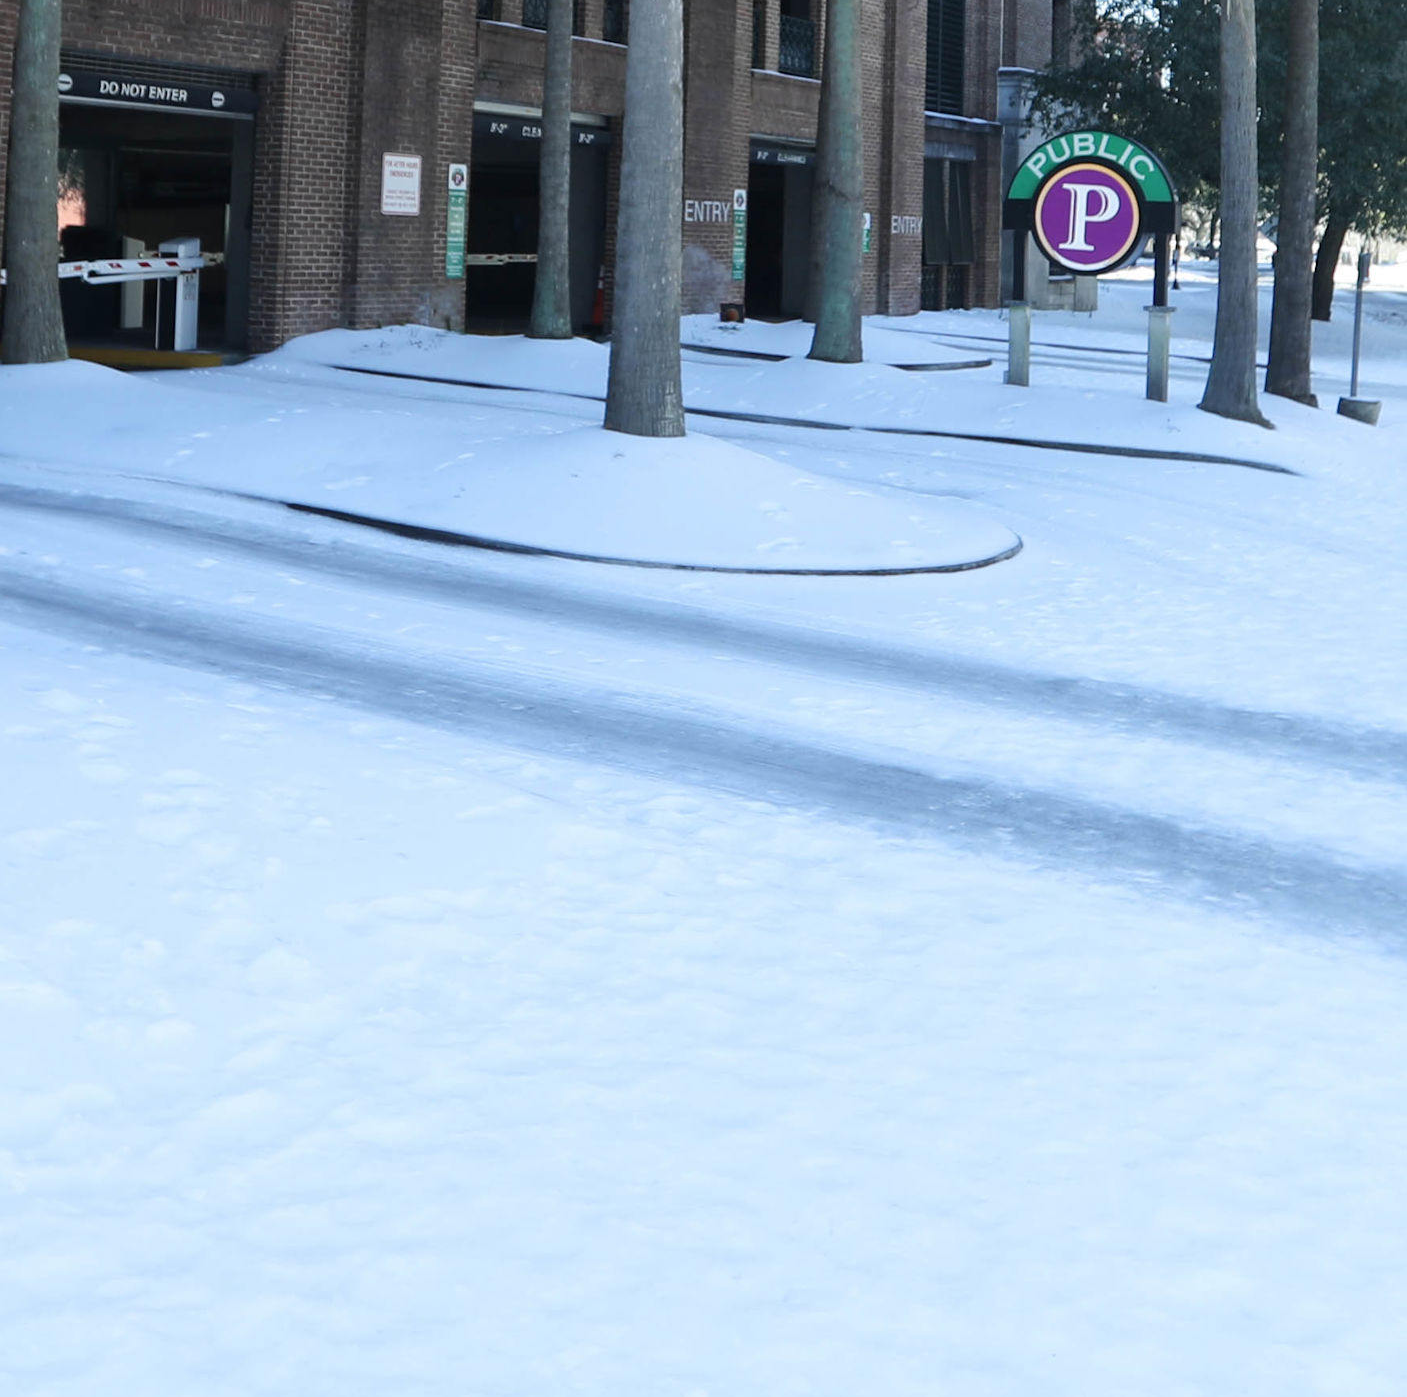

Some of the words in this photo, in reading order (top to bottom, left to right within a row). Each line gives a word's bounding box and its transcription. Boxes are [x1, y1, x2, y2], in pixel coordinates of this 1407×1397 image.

[99, 80, 119, 94] DO
[121, 83, 146, 97] NOT
[148, 86, 188, 102] ENTER
[1025, 133, 1155, 180] PUBLIC
[684, 199, 731, 222] ENTRY
[1058, 183, 1120, 251] P
[891, 215, 923, 234] ENTRY
